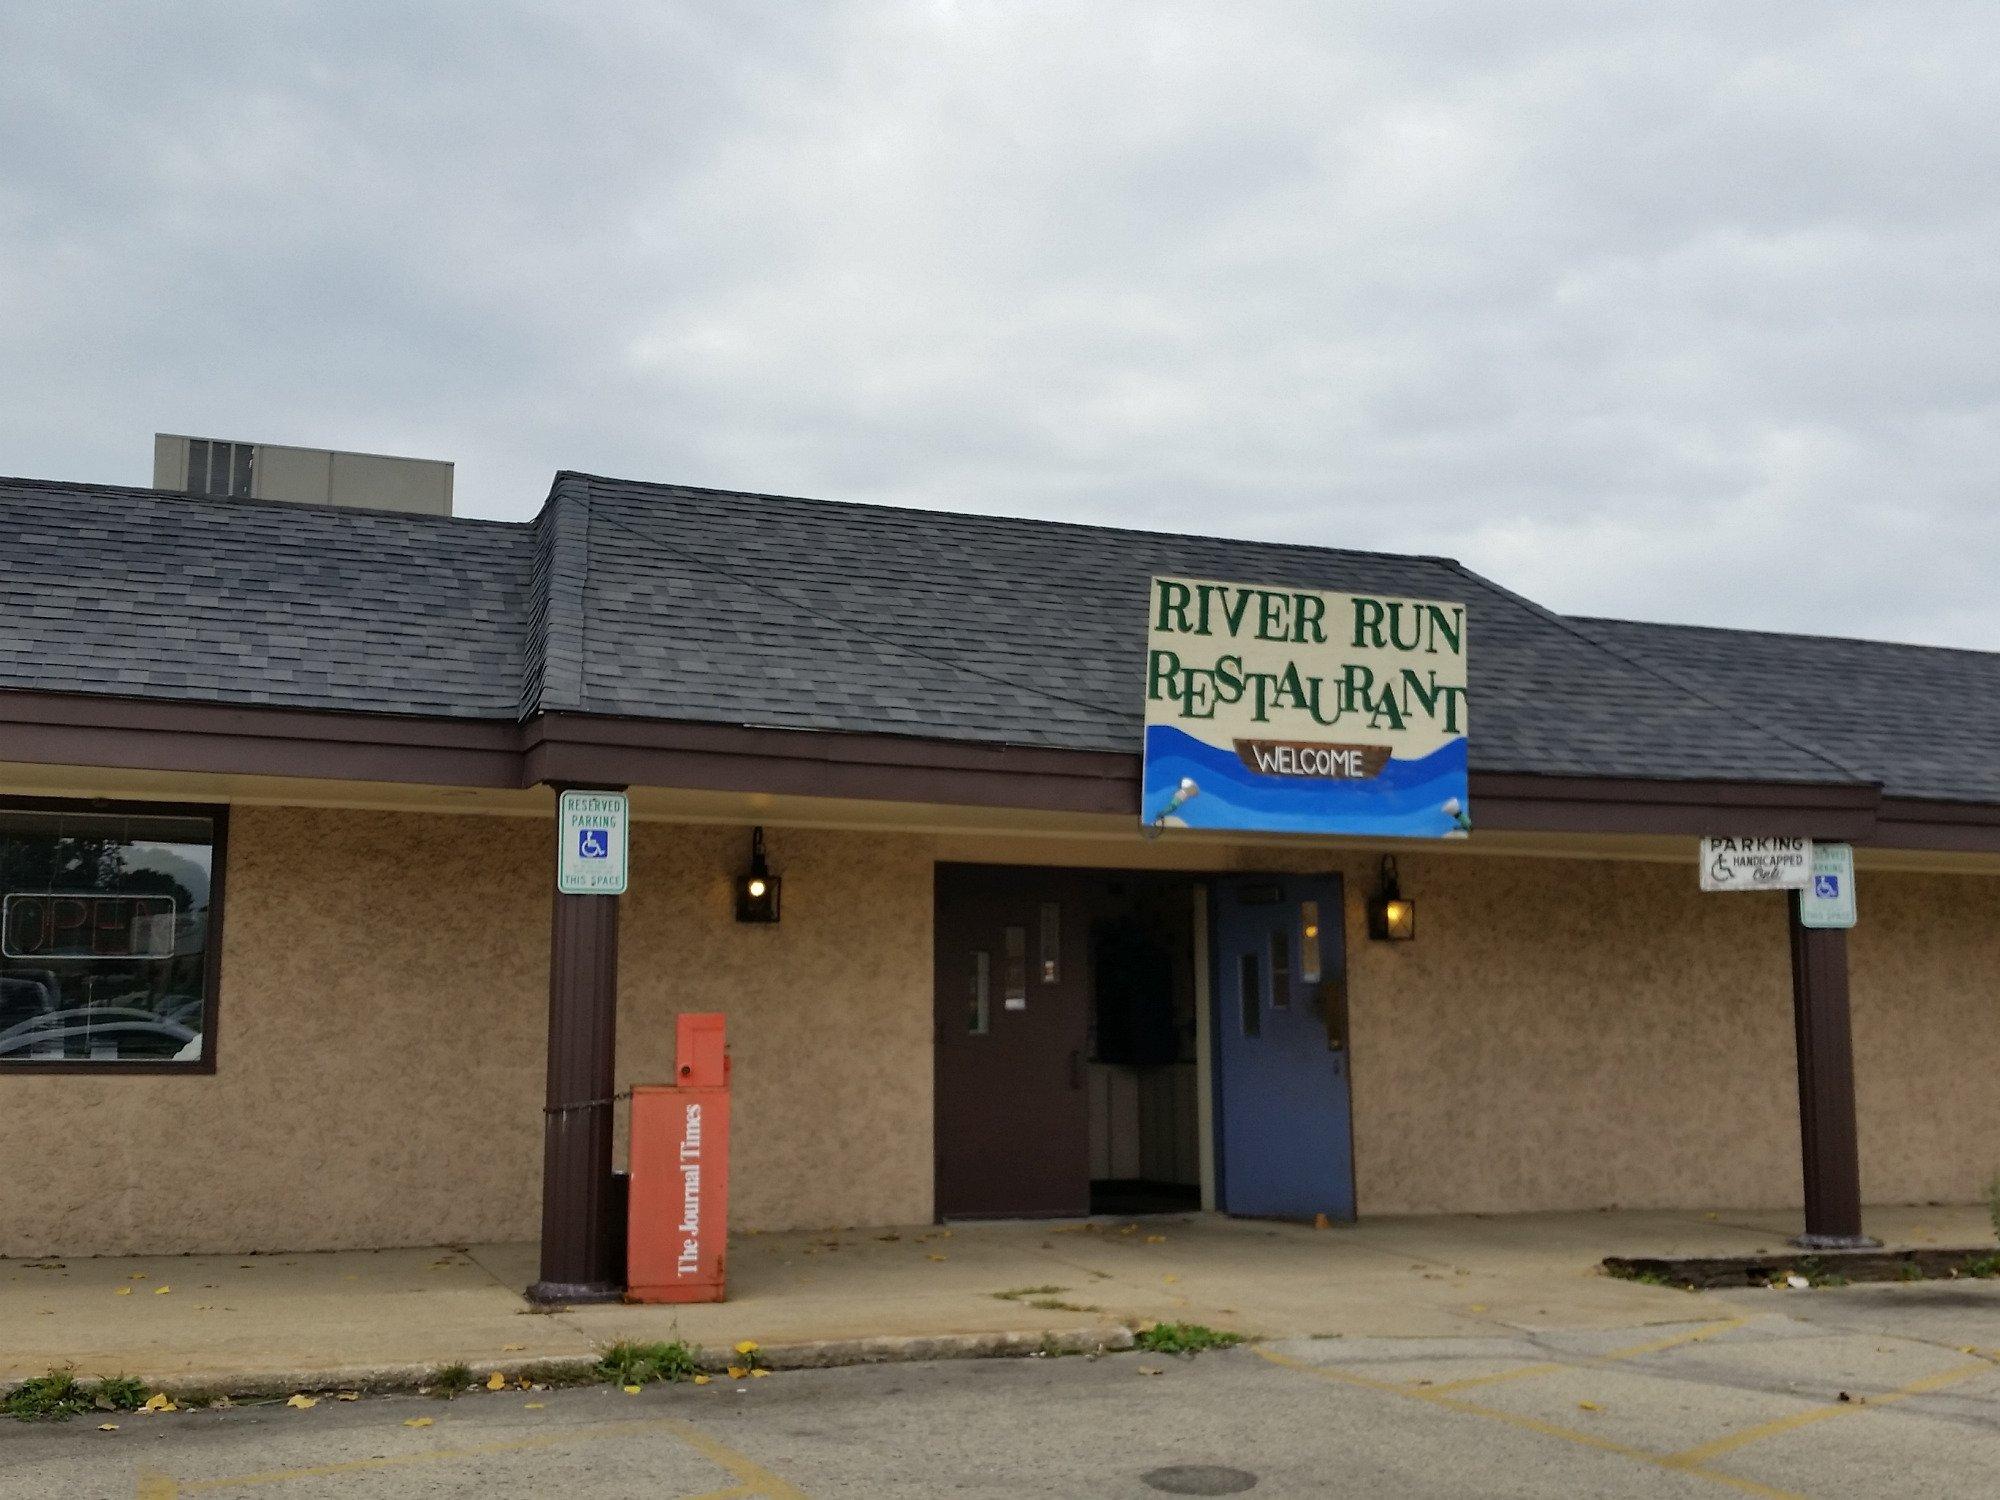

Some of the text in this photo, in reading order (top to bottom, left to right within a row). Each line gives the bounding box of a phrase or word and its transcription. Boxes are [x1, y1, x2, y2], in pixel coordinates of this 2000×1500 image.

[1155, 578, 1464, 655] RIVER RUN
[1148, 649, 1468, 734] RESTAURANT
[1252, 744, 1364, 778] WELCOME
[567, 798, 621, 813] RESERVED
[571, 814, 616, 829] PARKING
[1710, 836, 1804, 852] PARKING
[1733, 853, 1803, 867] HANDICAPPED
[564, 874, 620, 887] THIS SPACE
[677, 1103, 701, 1278] The Journal Times
